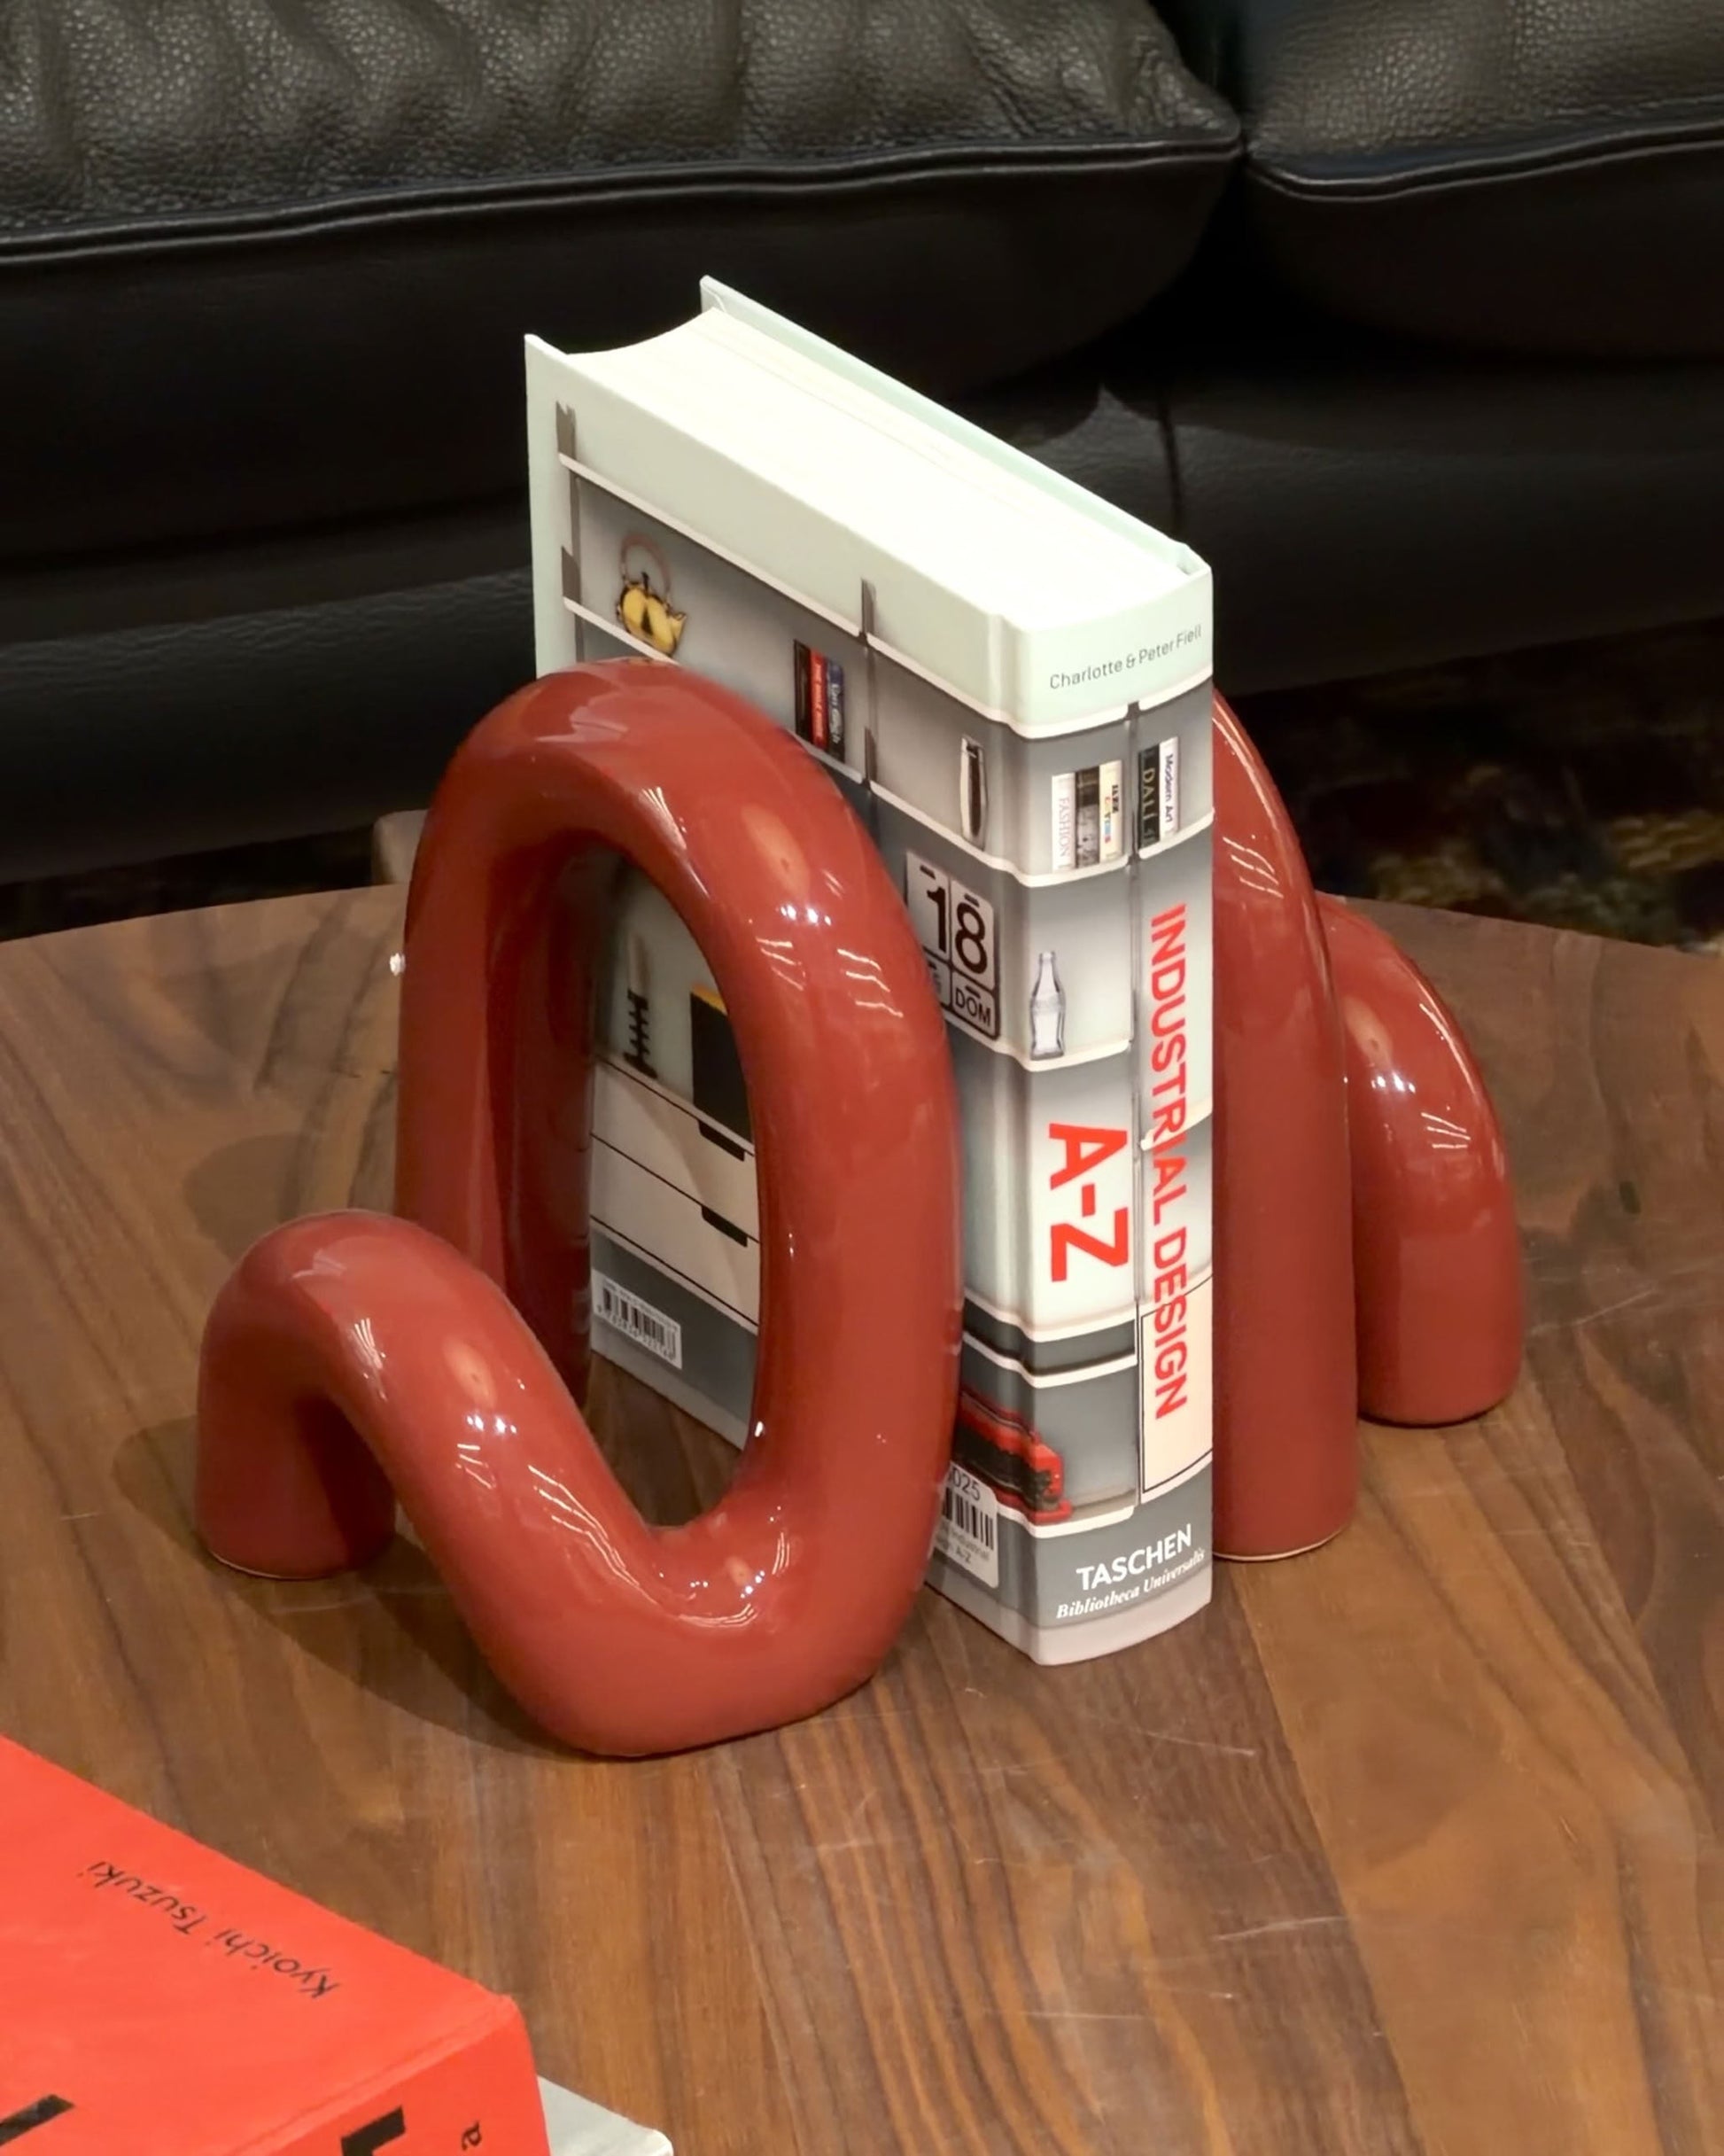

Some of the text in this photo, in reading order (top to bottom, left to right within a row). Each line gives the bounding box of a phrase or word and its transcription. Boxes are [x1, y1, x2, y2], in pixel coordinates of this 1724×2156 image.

[1050, 624, 1202, 689] Charlotte & Peter Fiell
[1059, 797, 1070, 857] FASHION
[1142, 766, 1157, 821] DALI
[927, 886, 989, 975] 18
[955, 986, 991, 1027] DOM
[1151, 902, 1188, 1420] INDUSTRIAL DESIGN
[1049, 1123, 1129, 1282] A-Z
[949, 1467, 981, 1501] 025
[1056, 1547, 1206, 1619] Bibliotheca Universalis
[1076, 1523, 1192, 1592] TASCHEN
[76, 1861, 340, 1998] Kyoichi Tsuzuki
